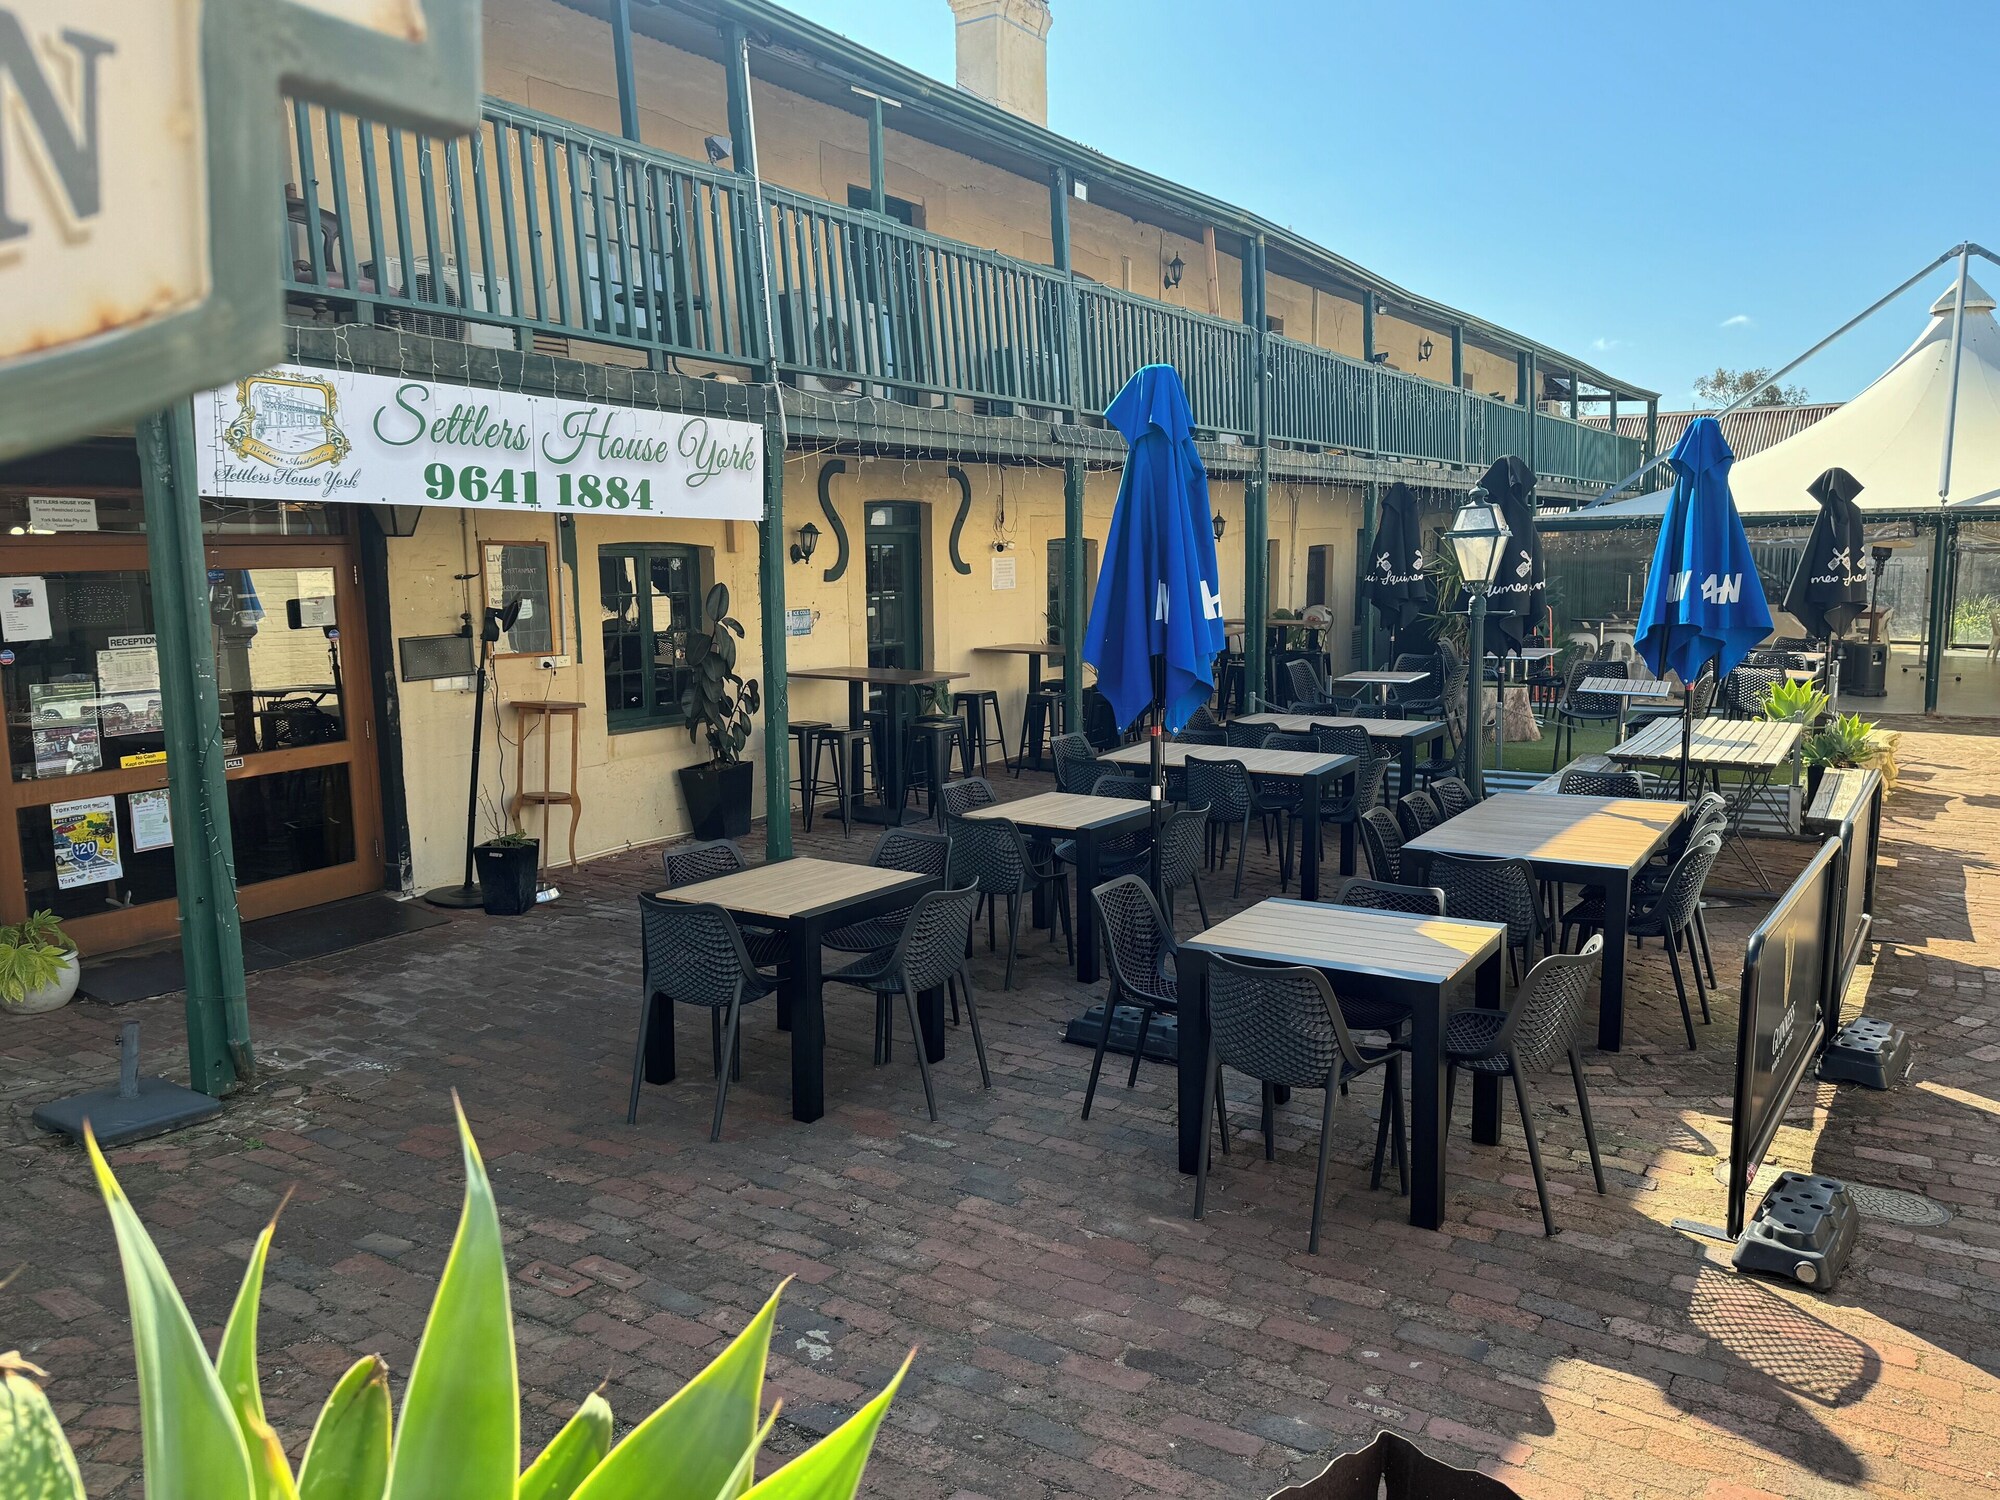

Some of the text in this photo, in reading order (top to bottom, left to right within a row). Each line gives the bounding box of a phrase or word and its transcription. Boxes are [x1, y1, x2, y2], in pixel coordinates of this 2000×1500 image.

[373, 383, 757, 488] Settlers House York
[249, 444, 330, 466] Western Australia
[214, 465, 362, 498] Settlers House York
[424, 462, 654, 510] 9641 1884
[110, 636, 157, 647] RECEPTION
[74, 842, 96, 855] 120
